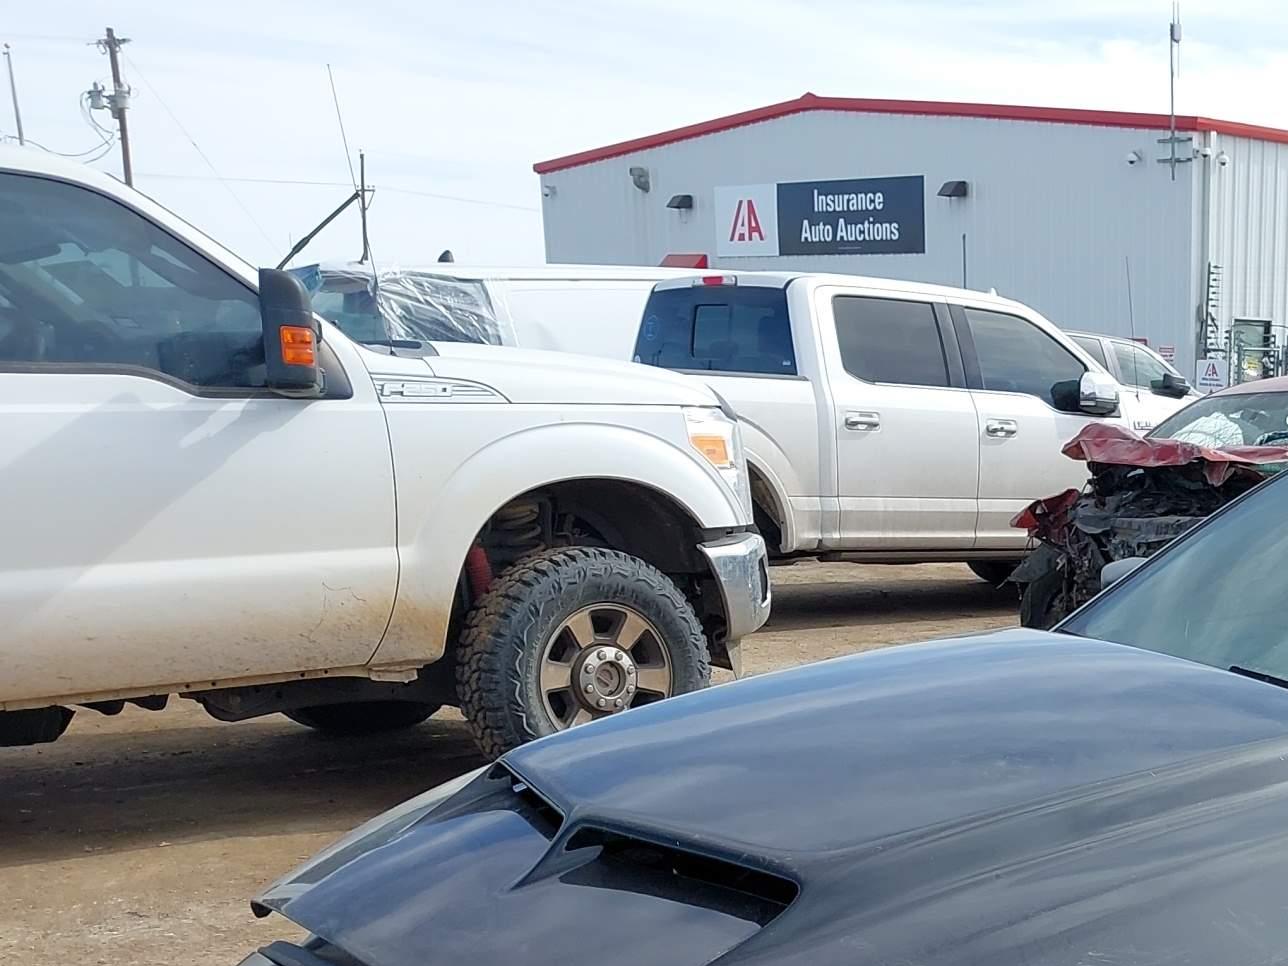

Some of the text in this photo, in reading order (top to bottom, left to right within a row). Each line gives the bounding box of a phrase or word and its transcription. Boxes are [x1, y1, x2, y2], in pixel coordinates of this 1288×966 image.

[813, 189, 884, 213] Insurance
[800, 217, 900, 243] Auto Auctions
